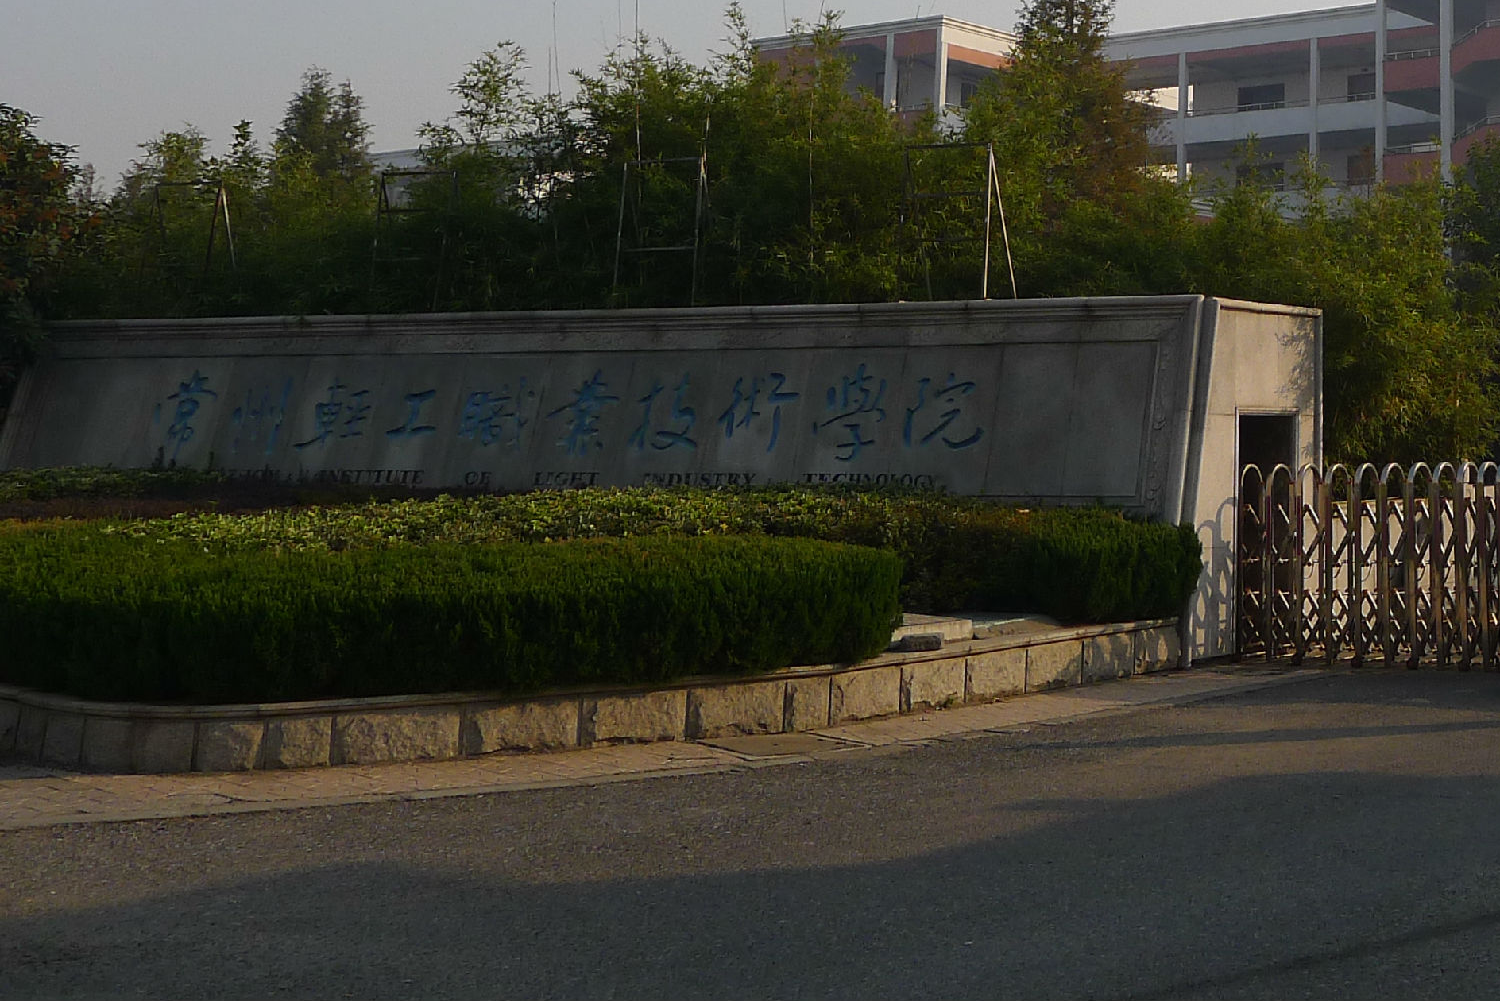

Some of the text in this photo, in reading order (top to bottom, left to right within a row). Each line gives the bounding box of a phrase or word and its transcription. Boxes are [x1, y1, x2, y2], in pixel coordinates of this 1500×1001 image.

[318, 469, 425, 484] INSTITUTE
[464, 471, 492, 486] OF
[533, 471, 600, 487] LIGHT
[643, 472, 757, 487] INDUSTRY
